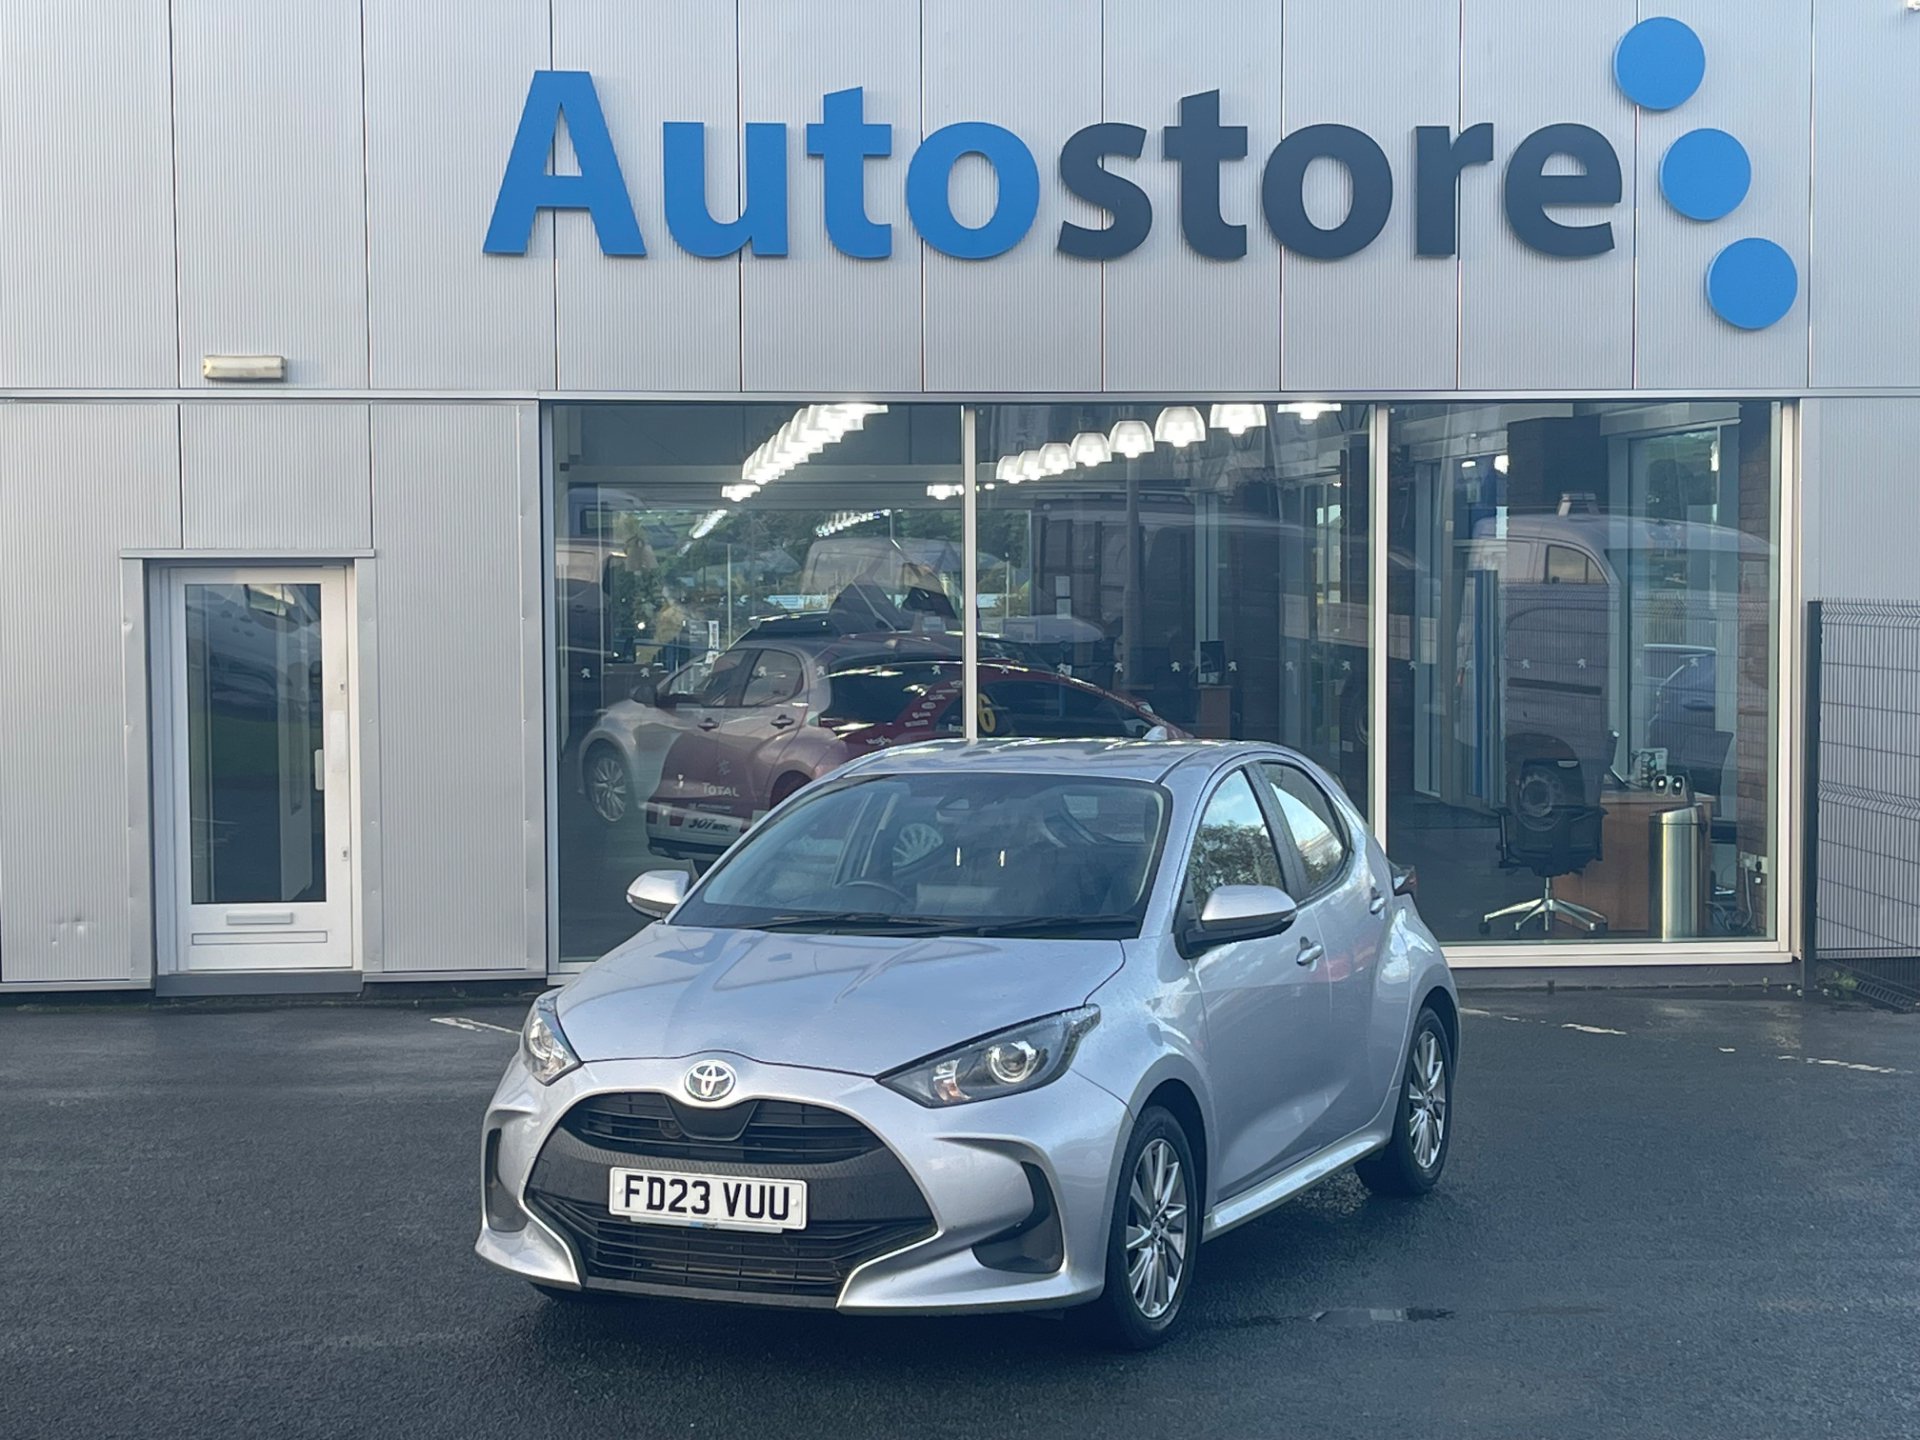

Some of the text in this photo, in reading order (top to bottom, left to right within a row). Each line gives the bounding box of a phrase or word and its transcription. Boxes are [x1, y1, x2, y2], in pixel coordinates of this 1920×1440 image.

[482, 69, 1623, 261] Autostore
[702, 782, 740, 797] TOTAL
[625, 1174, 789, 1221] FD23 VUU
